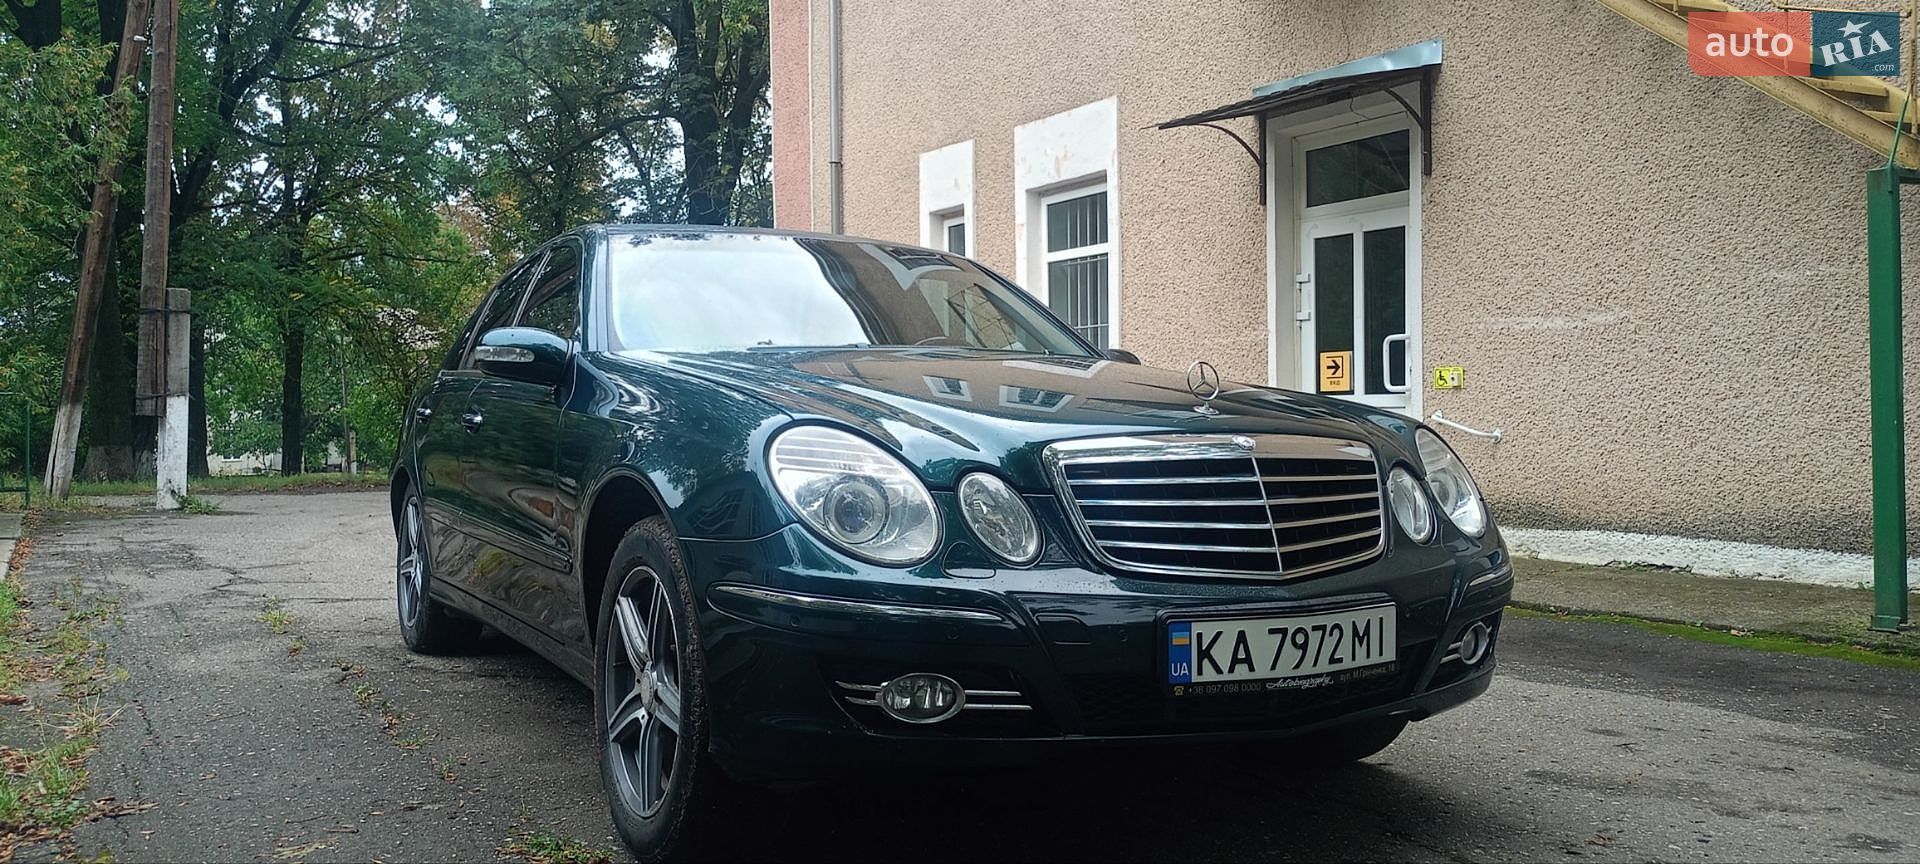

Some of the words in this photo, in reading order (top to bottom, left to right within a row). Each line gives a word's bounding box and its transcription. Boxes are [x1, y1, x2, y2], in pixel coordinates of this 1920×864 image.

[1196, 629, 1256, 676] KA
[1267, 623, 1344, 671] 7972
[1351, 616, 1384, 662] MI
[1171, 663, 1189, 676] UA
